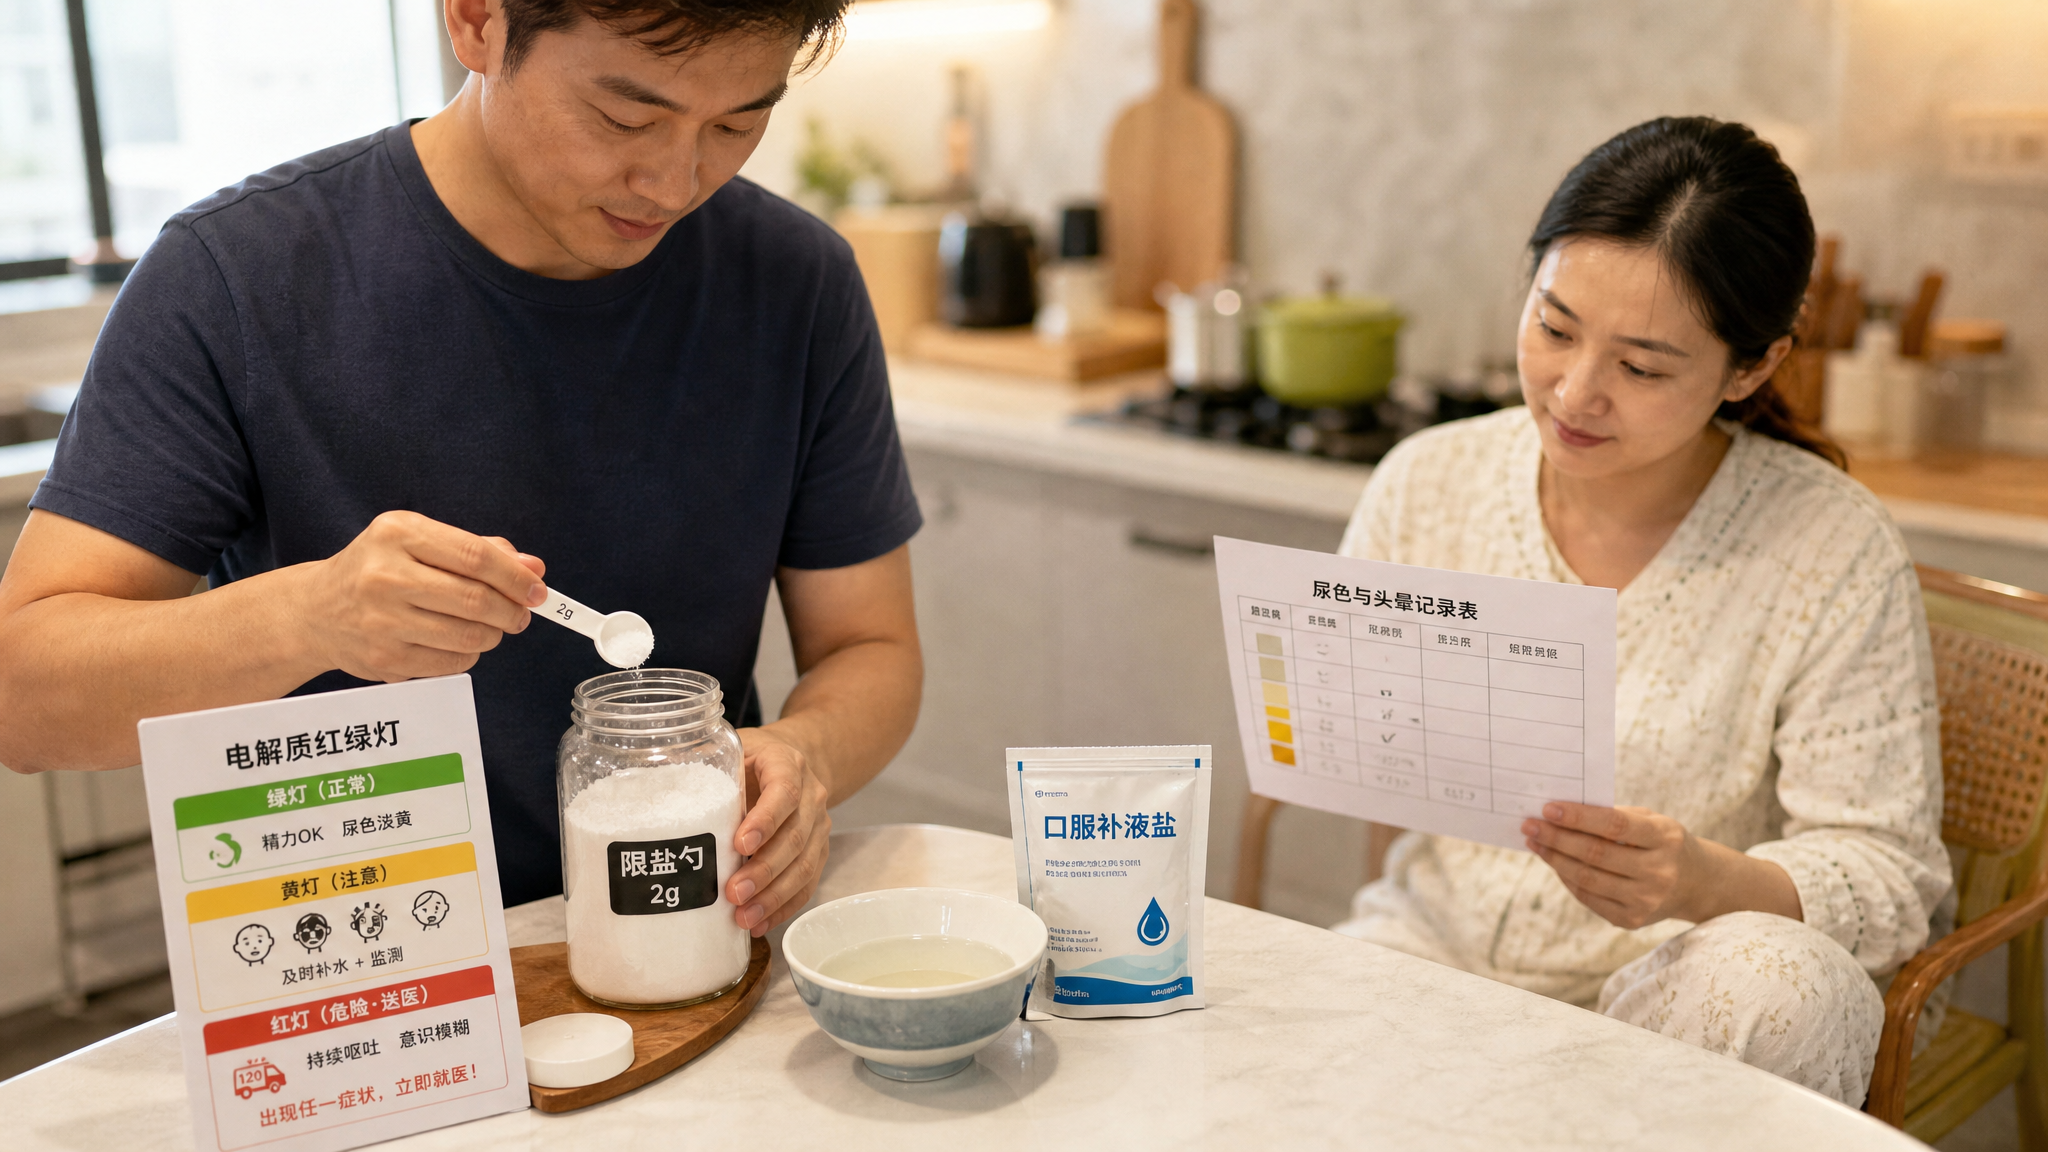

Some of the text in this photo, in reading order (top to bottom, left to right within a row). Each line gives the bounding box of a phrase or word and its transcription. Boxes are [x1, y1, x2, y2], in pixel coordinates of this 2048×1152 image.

[556, 603, 574, 620] 2g
[226, 720, 400, 769] 电解质红绿灯
[262, 810, 412, 851] 精力OK 尿色淡黄
[1044, 812, 1177, 840] 口服补液盐
[620, 846, 703, 877] 限盐勺
[650, 884, 680, 907] 2g
[281, 958, 349, 986] 及时补水
[307, 1019, 470, 1070] 持续呕吐 意识模糊
[239, 1070, 262, 1085] 120
